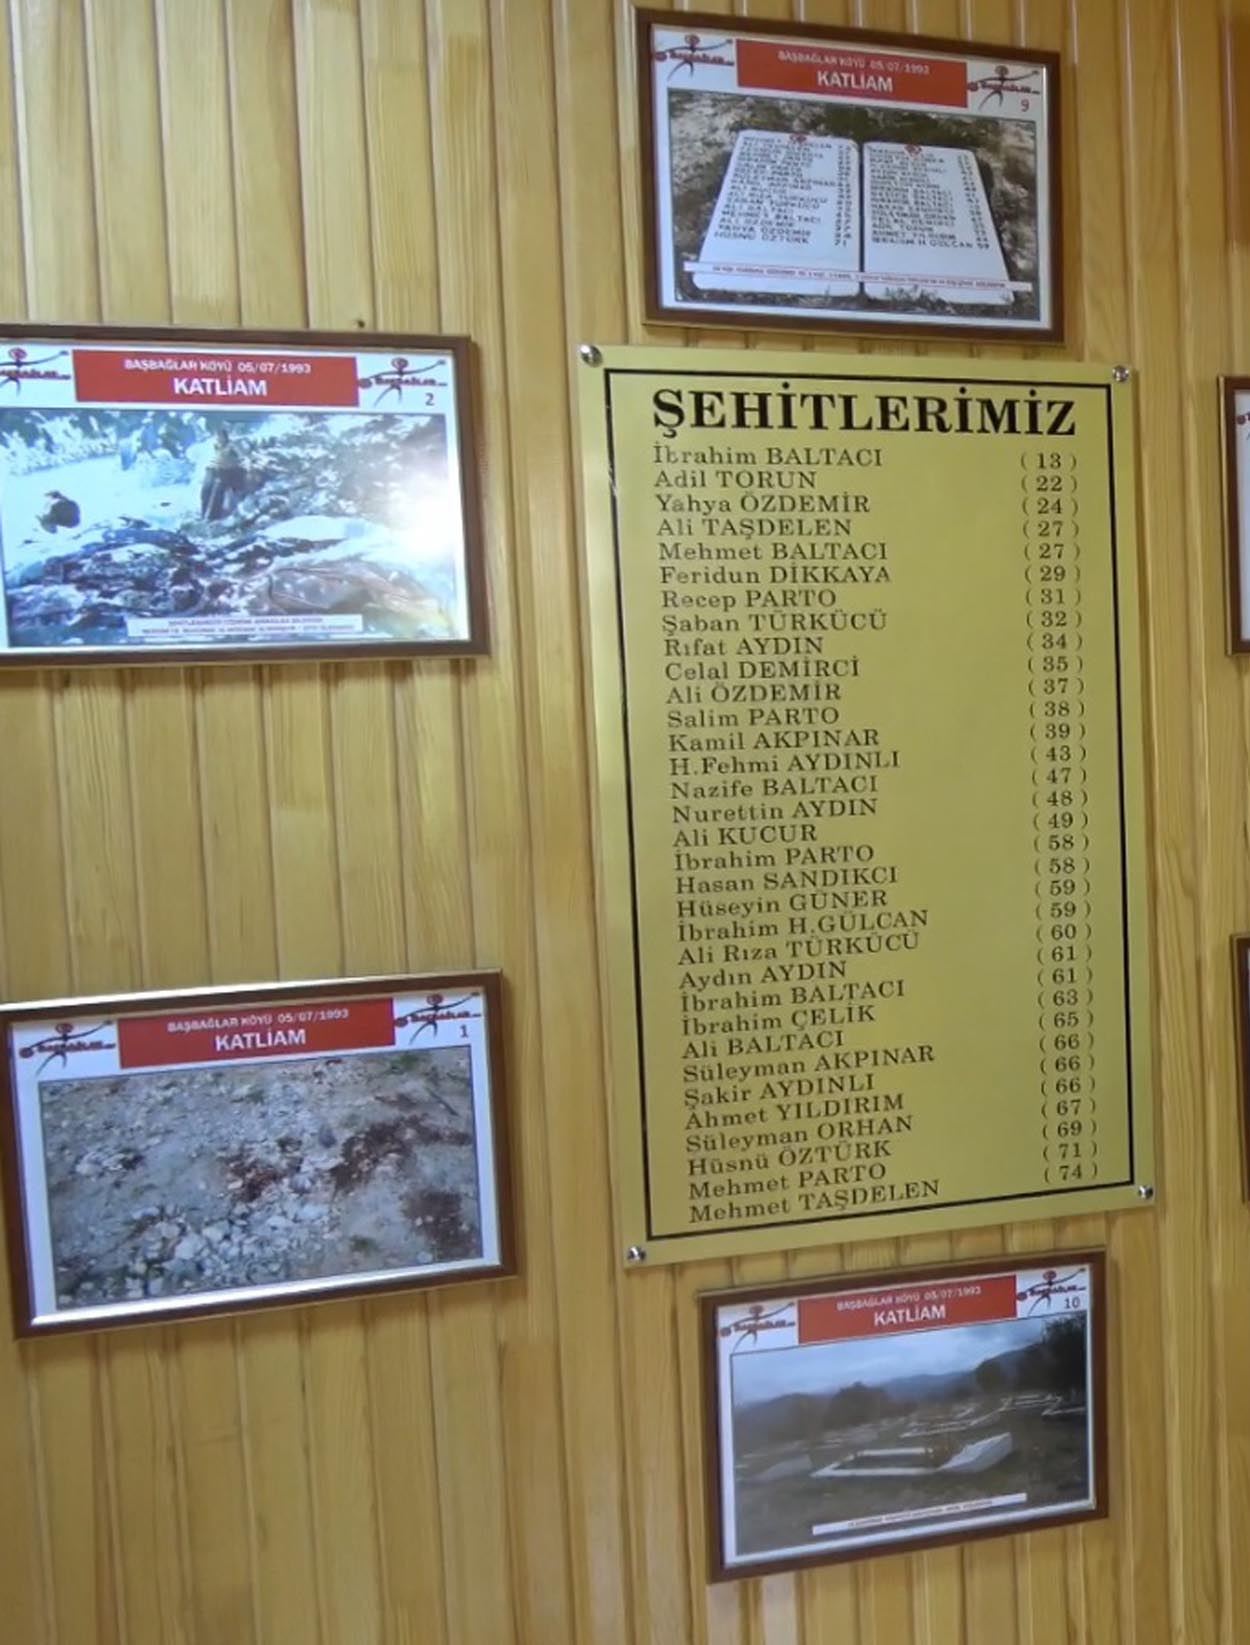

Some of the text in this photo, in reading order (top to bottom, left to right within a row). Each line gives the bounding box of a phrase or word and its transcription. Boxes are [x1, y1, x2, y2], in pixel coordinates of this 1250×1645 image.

[817, 70, 893, 92] KATLİAM
[1021, 99, 1030, 112] 9
[124, 358, 311, 374] BAŞBAĞLAR KÖYÜ 05/07/1993
[173, 374, 267, 396] KATLİAM
[425, 393, 435, 406] 2
[651, 382, 1076, 438] ŞEHİTLERİMİZ
[652, 440, 757, 464] İbrahim
[764, 447, 883, 466] BALTACI
[652, 469, 707, 488] Adil
[714, 469, 817, 488] TORUN
[654, 493, 732, 516] Yahya
[739, 491, 871, 512] ÖZDEMİR
[655, 517, 693, 536] Ali
[700, 518, 852, 540] TAŞDELEN
[657, 541, 763, 560] Mehmet
[770, 542, 888, 560] BALTACI
[658, 565, 761, 584] Feridun
[768, 561, 891, 583] DİKKAYA
[659, 590, 737, 612] Recep
[744, 588, 837, 607] PARTO
[660, 614, 740, 636] Şaban
[747, 608, 887, 631] TÜRKÜCÜ
[662, 637, 726, 656] Rıfat
[734, 636, 824, 655] AYDIN
[663, 661, 729, 681] Celal
[737, 655, 859, 678] DEMİRCİ
[664, 685, 702, 704] Ali
[709, 679, 842, 702] ÖZDEMİR
[666, 709, 739, 728] Salim
[747, 706, 840, 726] PARTO
[667, 731, 745, 752] Kamil
[751, 728, 880, 749] AKPINAR
[786, 750, 899, 771] AYDINLI
[670, 779, 753, 799] Nazife
[761, 774, 878, 796] BALTACI
[671, 802, 784, 823] Nurettin
[790, 797, 878, 818] AYDIN
[671, 828, 709, 847] Ali
[716, 823, 818, 845] KUCUR
[673, 849, 776, 871] İbrahim
[784, 844, 875, 865] PARTO
[675, 876, 755, 894] Hasan
[676, 896, 780, 923] Hüseyin
[788, 889, 888, 911] GÜNER
[676, 916, 779, 941] İbrahim
[676, 946, 714, 965] Ali
[722, 944, 778, 962] Rıza
[784, 929, 919, 958] TÜRKÜCÜ
[677, 968, 752, 993] Aydın
[759, 959, 847, 983] AYDIN
[680, 989, 782, 1012] İbrahim
[790, 978, 905, 1004] BALTACI
[167, 1008, 349, 1033] BAŞBAĞLAR KÖYÜ 05/07/1993
[459, 1025, 469, 1038] 1
[680, 1013, 782, 1036] İbrahim
[790, 1002, 876, 1031] ÇELİK
[215, 1028, 306, 1052] KATLİAM
[680, 1040, 718, 1059] Ali
[727, 1029, 844, 1055] BALTACI
[682, 1060, 806, 1082] Süleyman
[813, 1044, 935, 1071] AKPINAR
[683, 1084, 752, 1110] Şakir
[758, 1073, 874, 1099] AYDINLI
[683, 1108, 766, 1130] Ahmet
[774, 1092, 904, 1120] YILDIRIM
[685, 1130, 808, 1152] Süleyman
[816, 1114, 913, 1139] ORHAN
[686, 1153, 769, 1176] Hüsnü
[777, 1139, 892, 1166] ÖZTÜRK
[688, 1175, 790, 1200] Mehmet
[797, 1162, 887, 1188] PARTO
[688, 1198, 787, 1223] Mehmet
[797, 1178, 939, 1210] TAŞDELEN
[874, 1303, 946, 1327] KATLİAM
[1065, 1297, 1081, 1309] 10
